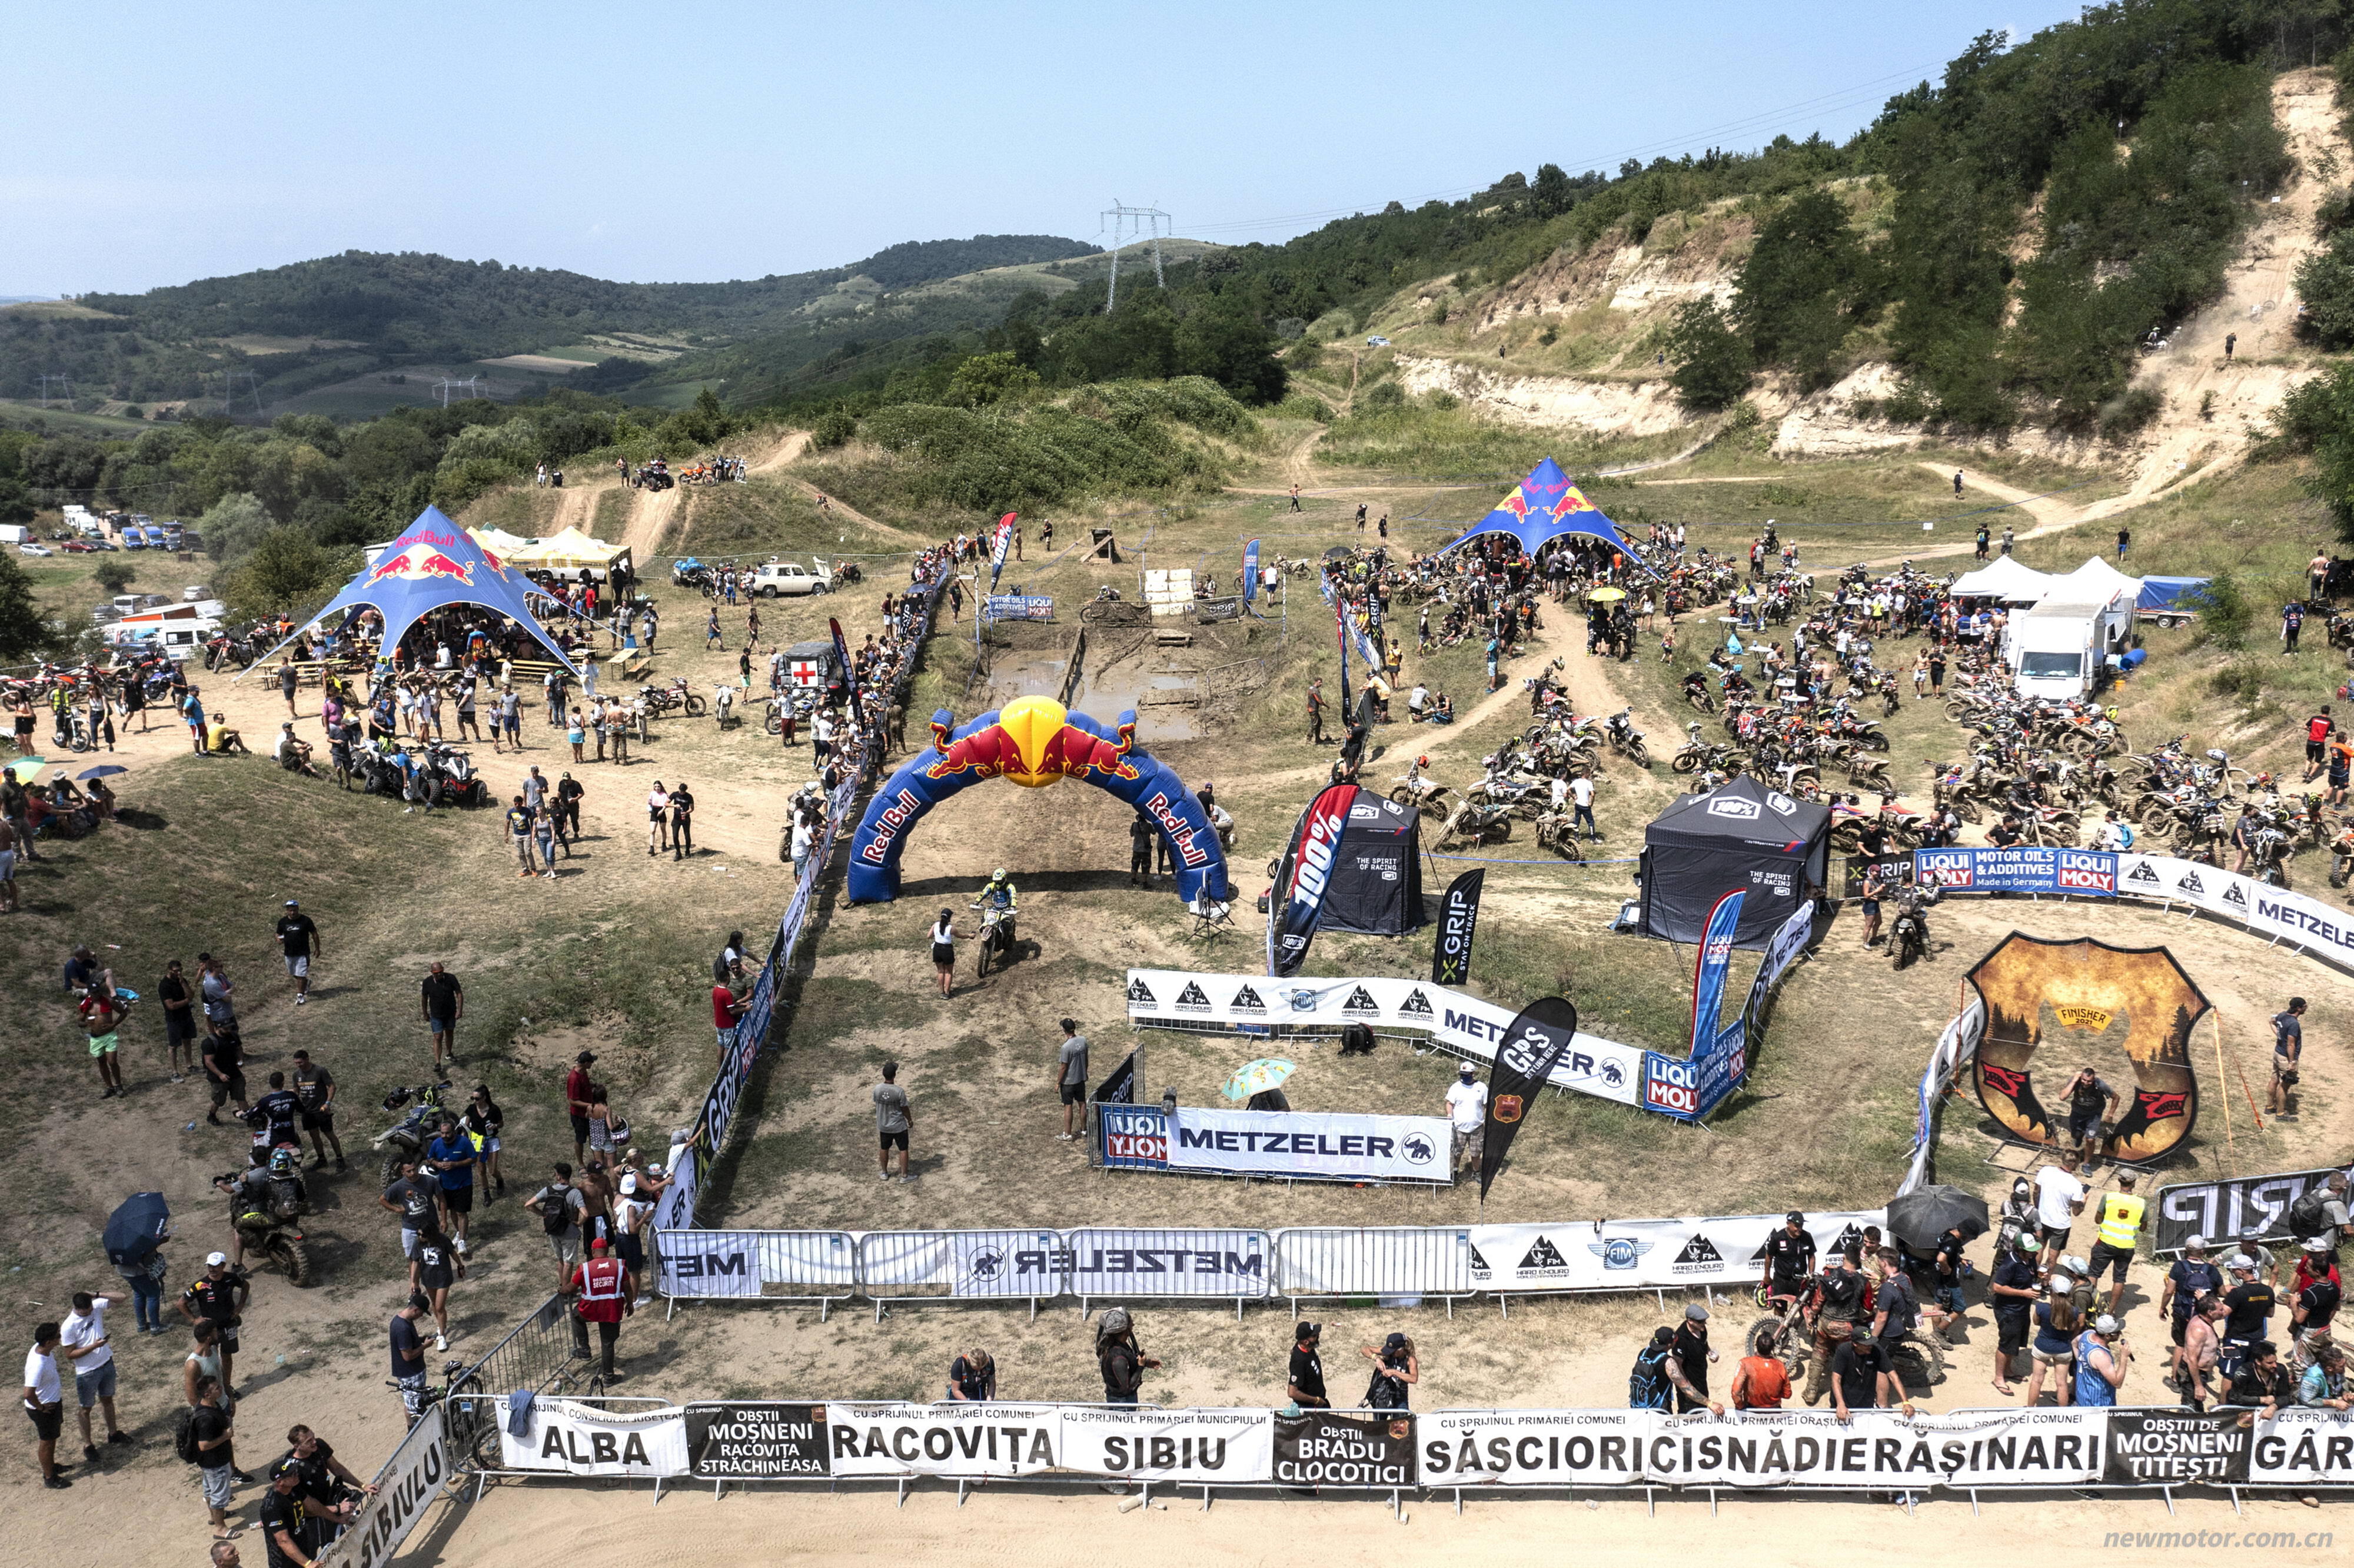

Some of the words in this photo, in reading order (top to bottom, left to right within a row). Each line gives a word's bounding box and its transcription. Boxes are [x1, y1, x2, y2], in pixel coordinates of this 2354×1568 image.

[395, 530, 424, 548] Red
[423, 530, 455, 548] Bull
[993, 523, 1012, 565] 100%
[1029, 598, 1052, 607] LIQUI
[1029, 607, 1052, 615] MOLY
[1714, 801, 1754, 815] 100%
[862, 820, 896, 863] Red
[881, 788, 921, 829] Bull
[1146, 791, 1188, 833] Red
[1172, 826, 1208, 866] Bull
[1294, 810, 1342, 909] 100%
[1921, 854, 1970, 871] LIQUI
[1976, 851, 2021, 863] MOTOR
[2025, 852, 2054, 863] OILS
[2062, 855, 2112, 873] LIQUI
[1766, 873, 1791, 881] SPIRIT
[1987, 864, 2054, 875] ADDITIVES
[1764, 878, 1790, 887] RACING
[2013, 878, 2053, 888] Germany
[2062, 871, 2113, 890] MOLY
[1465, 904, 1475, 932] TRACK
[1284, 937, 1304, 948] 100%
[1442, 890, 1467, 982] X-GRIP
[1464, 937, 1471, 947] ON
[1710, 936, 1733, 945] LIQU
[1708, 945, 1730, 954] MOL
[1459, 950, 1468, 970] STAY
[1296, 995, 1312, 1004] FIM
[2061, 1008, 2106, 1024] FINISHER
[1444, 1008, 1595, 1076] METER
[1503, 1027, 1550, 1073] GPS
[1524, 1057, 1547, 1080] RETURN
[1543, 1043, 1558, 1060] HERE
[1650, 1082, 1700, 1113] MOLY
[1180, 1128, 1394, 1158] METZELER
[1610, 1247, 1632, 1260] FIM
[593, 1280, 614, 1289] SECURITY
[530, 1402, 566, 1416] RIJINUL
[736, 1411, 779, 1424] OBȘTII
[853, 1410, 869, 1418] CU
[872, 1410, 923, 1419] SPRIJINUL
[986, 1410, 1035, 1419] COMUNEI
[1063, 1413, 1078, 1421] CU
[1081, 1413, 1136, 1423] SPRIJINUL
[1197, 1415, 1266, 1424] MUNICIPIULUI
[1441, 1420, 1456, 1428] CU
[1459, 1417, 1514, 1427] SPRIJINUL
[1518, 1415, 1574, 1425] PRIMĂRIEI
[1578, 1416, 1625, 1424] COMUNEI
[1665, 1418, 1680, 1428] CU
[1683, 1416, 1738, 1427] SPRIJINUL
[2033, 1414, 2082, 1424] COMUNEI
[2143, 1419, 2195, 1434] OBȘTII
[2199, 1420, 2220, 1431] DE
[2279, 1414, 2293, 1423] CU
[709, 1423, 813, 1443] MOȘNENI
[1321, 1426, 1362, 1440] OBȘTII
[541, 1425, 651, 1466] ALBA
[721, 1444, 800, 1459] RACOVIȚA
[832, 1424, 1055, 1474] RACOVIȚA
[1299, 1439, 1385, 1462] BRADU
[1425, 1430, 1643, 1473] SĂSCIORI
[1650, 1429, 1867, 1473] CISNĂDIE
[2117, 1433, 2243, 1457] MOȘNENI
[2255, 1428, 2354, 1471] GÂR
[1103, 1436, 1226, 1472] SIBIU
[1875, 1430, 2100, 1482] RĂȘINARI
[701, 1456, 823, 1473] STRĂCHINEASA
[1278, 1461, 1405, 1483] CLOCOTICI
[2129, 1456, 2227, 1480] TITEȘTI
